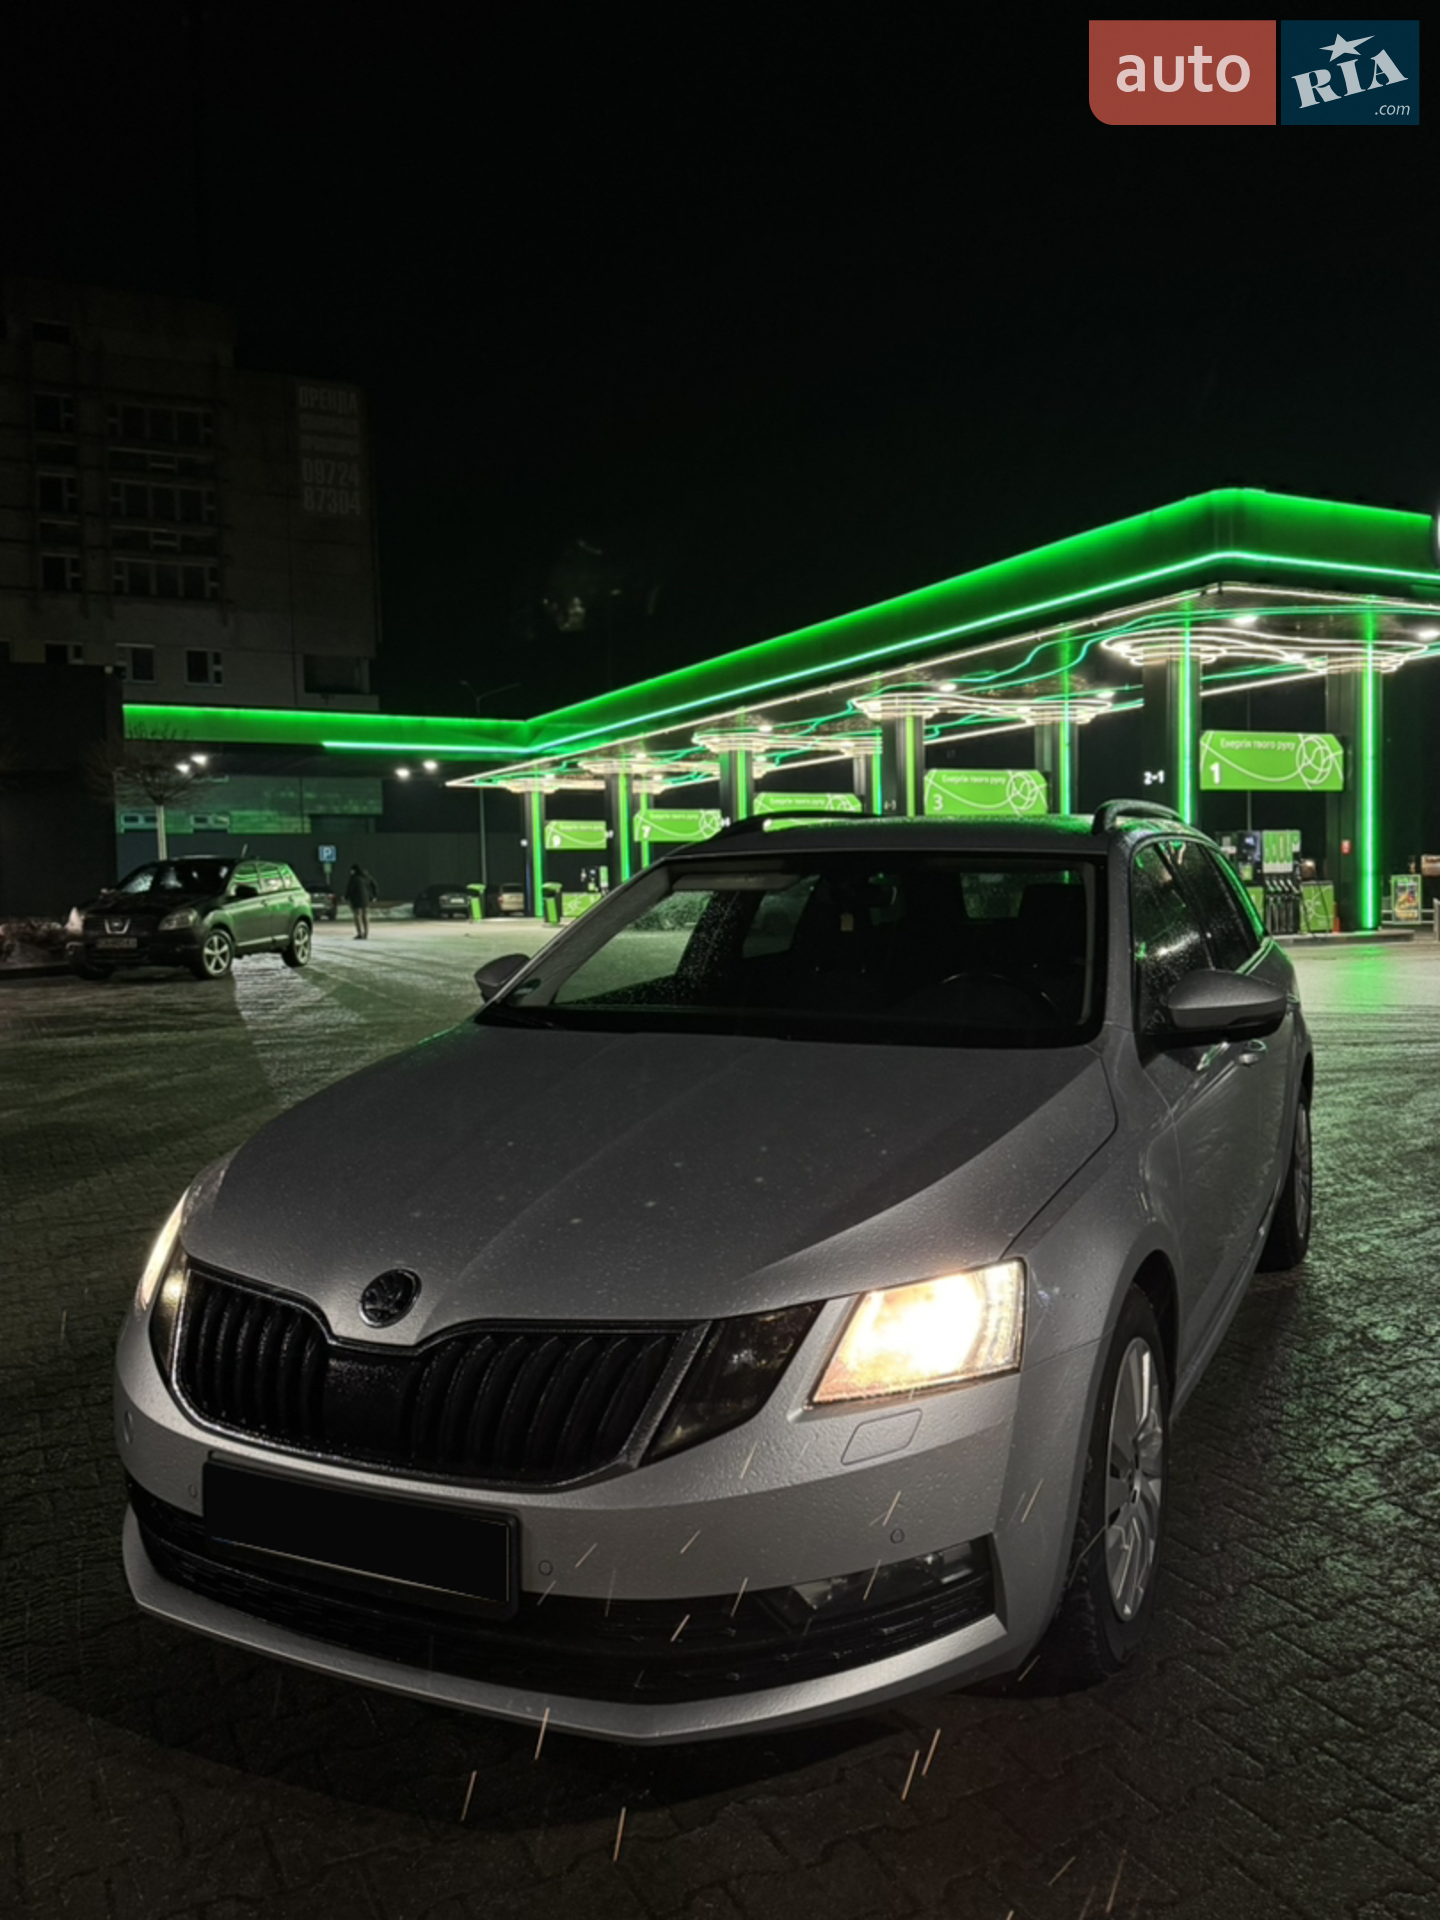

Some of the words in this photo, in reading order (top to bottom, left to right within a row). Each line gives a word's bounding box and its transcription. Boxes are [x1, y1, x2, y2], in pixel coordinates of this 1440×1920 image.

[298, 385, 359, 416] ОРЕНДА
[302, 457, 360, 488] 09724
[303, 485, 361, 517] 87304
[1209, 761, 1221, 785] 1
[932, 794, 943, 812] 3
